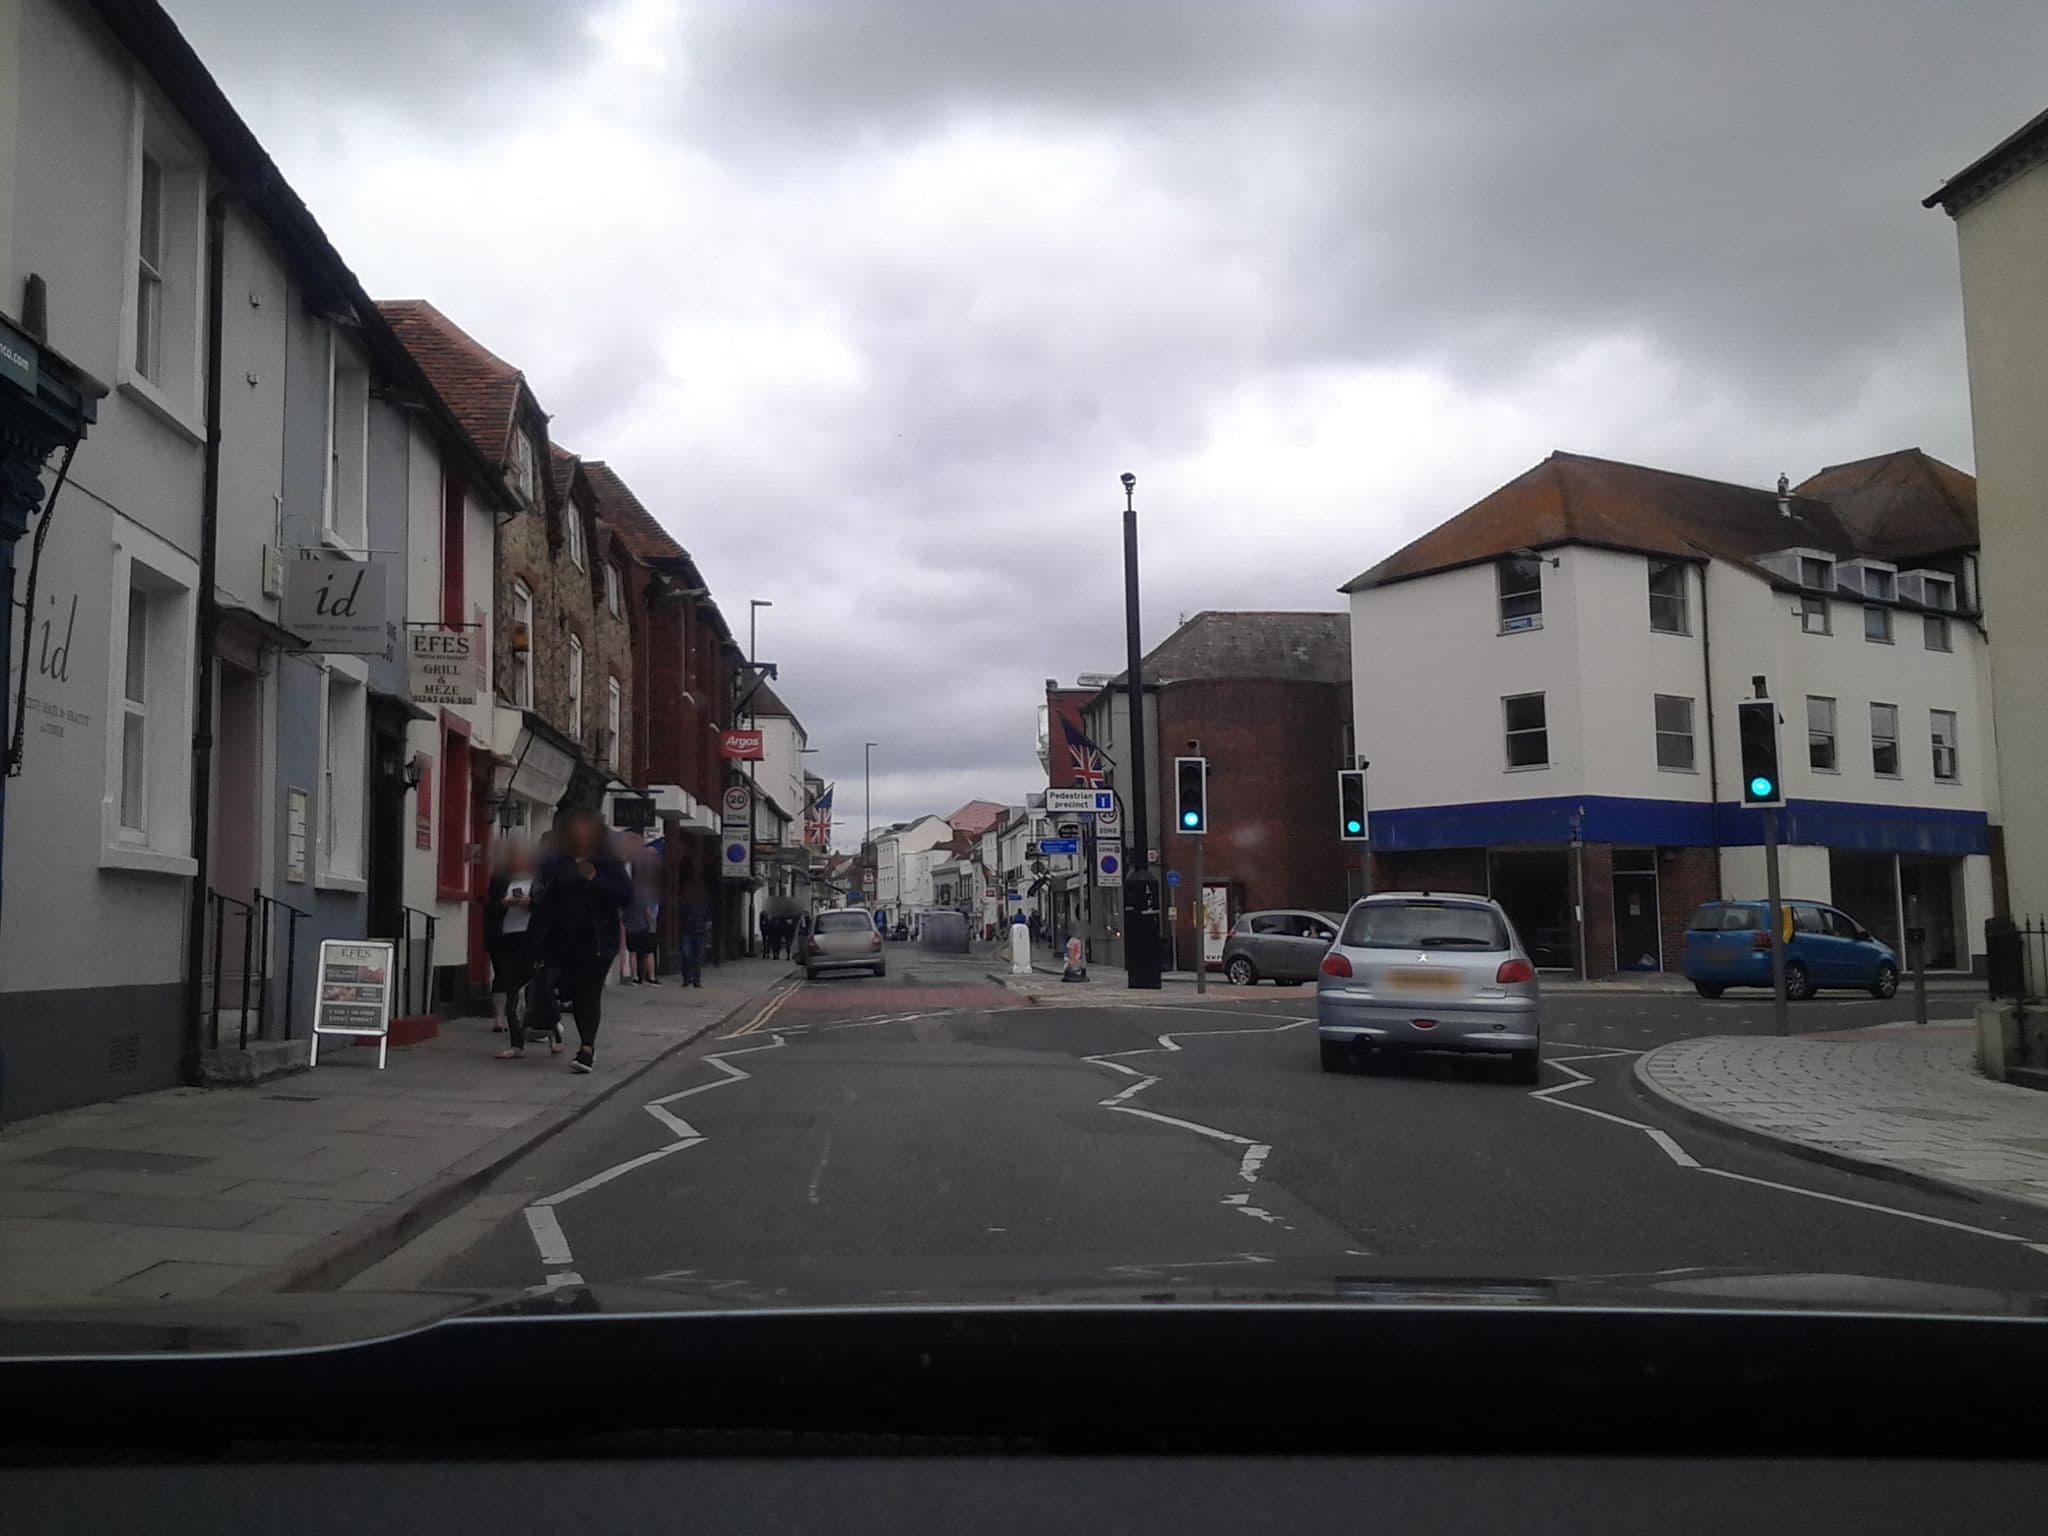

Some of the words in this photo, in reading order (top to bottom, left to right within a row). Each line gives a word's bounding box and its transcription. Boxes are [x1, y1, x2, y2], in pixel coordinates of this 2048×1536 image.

[315, 569, 365, 617] id
[40, 594, 78, 683] id
[414, 635, 470, 654] EFES
[424, 664, 462, 676] GRILL
[424, 685, 460, 696] MEZE
[726, 735, 759, 750] Argos
[729, 795, 744, 804] 20
[1050, 791, 1093, 800] Pedestrian
[1055, 800, 1089, 809] precinct
[342, 948, 372, 959] EFES
